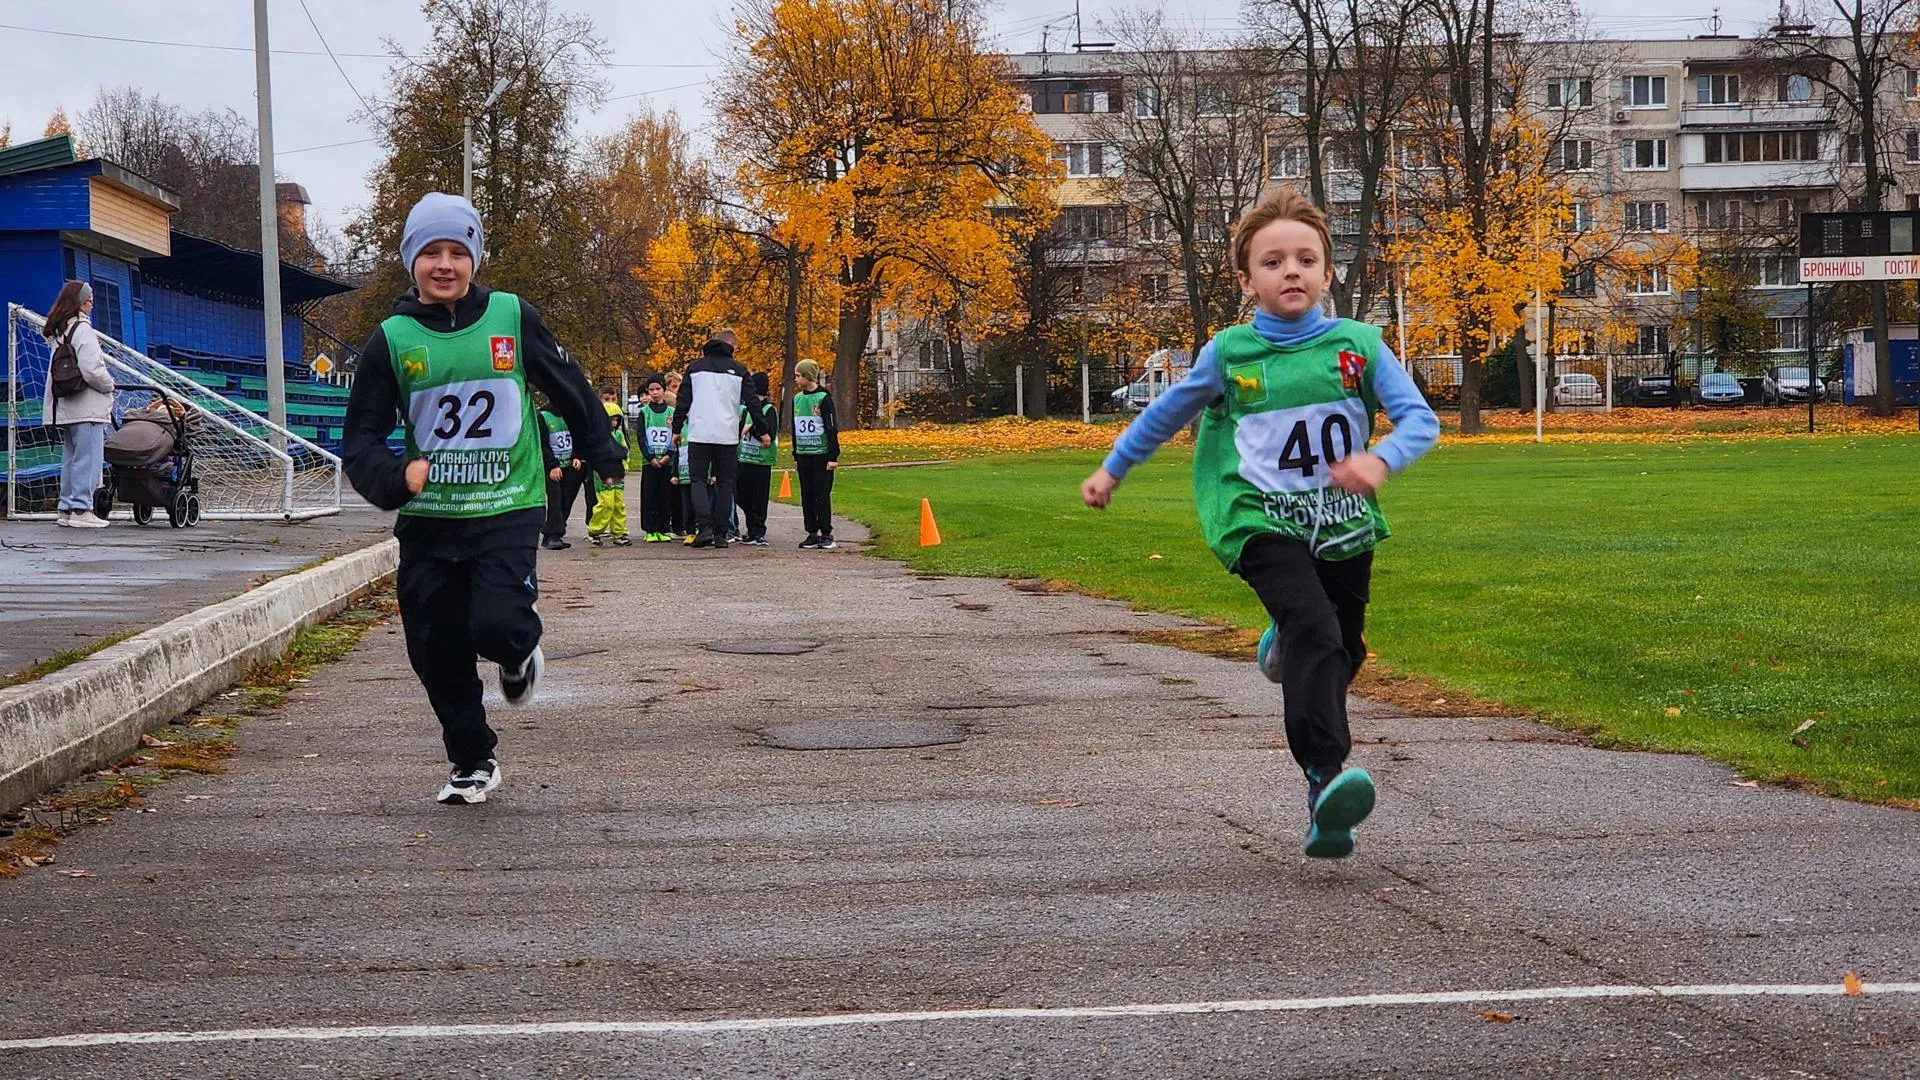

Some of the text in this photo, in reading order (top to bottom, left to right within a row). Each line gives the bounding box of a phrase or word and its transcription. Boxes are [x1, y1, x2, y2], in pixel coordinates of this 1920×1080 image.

[1803, 259, 1919, 277] БРОННИЦЫ ГОСТИ
[433, 390, 496, 440] 32
[799, 419, 816, 433] 36
[557, 434, 571, 449] 35
[651, 429, 668, 443] 25
[1278, 413, 1352, 478] 40
[480, 450, 510, 463] КЛУБ
